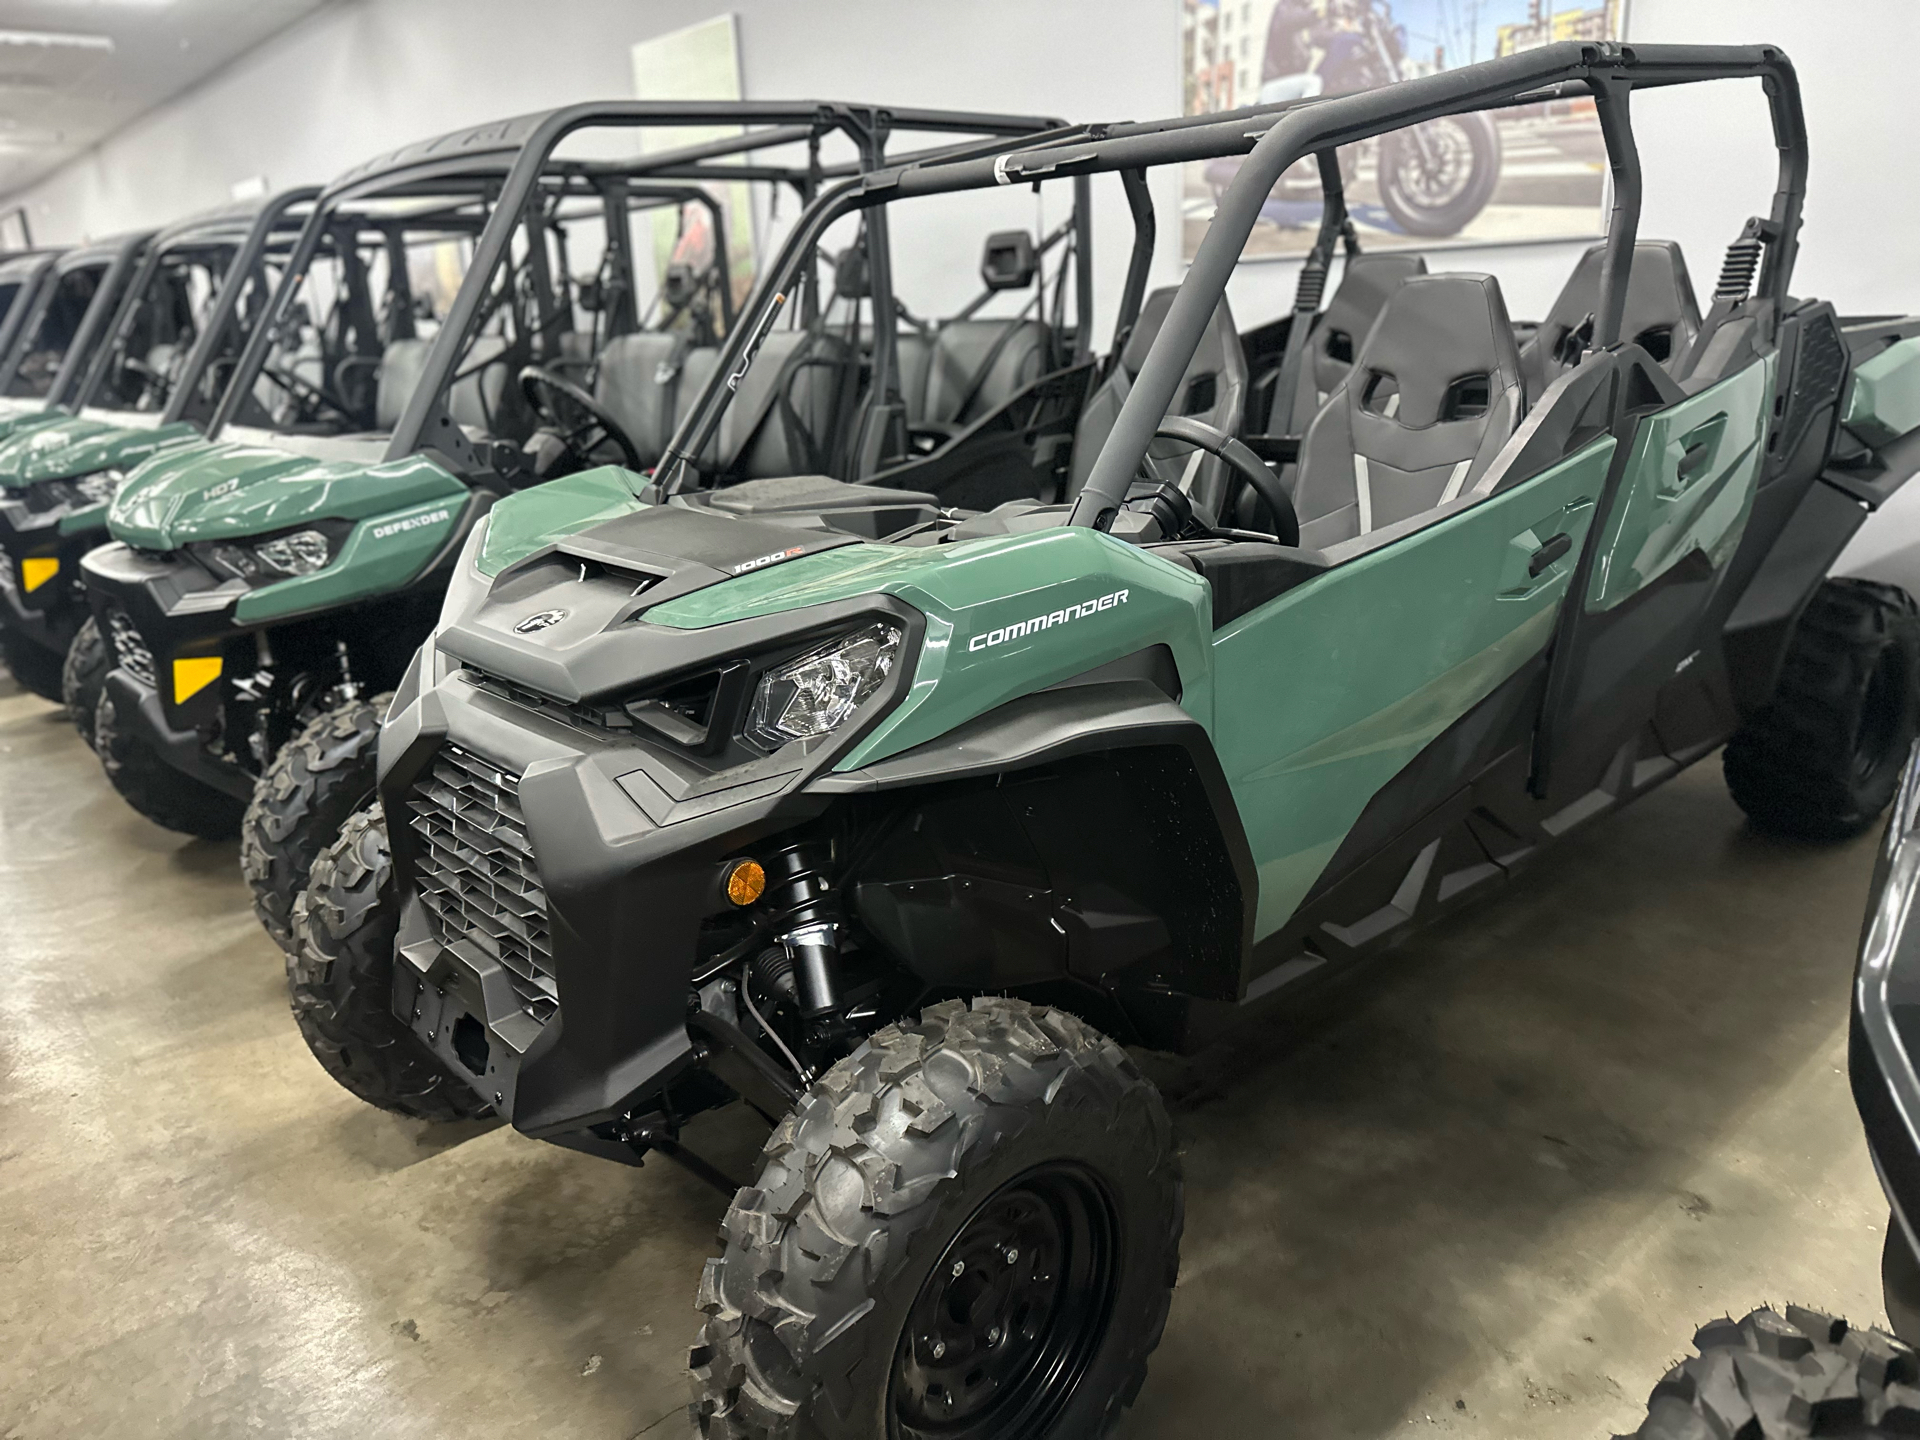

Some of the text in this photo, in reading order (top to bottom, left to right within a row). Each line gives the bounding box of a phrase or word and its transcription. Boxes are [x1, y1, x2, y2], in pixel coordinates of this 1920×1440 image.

[203, 477, 239, 500] HD7
[373, 510, 449, 539] DEFENDER
[734, 547, 804, 573] 1000R
[969, 588, 1129, 652] COMMANDER
